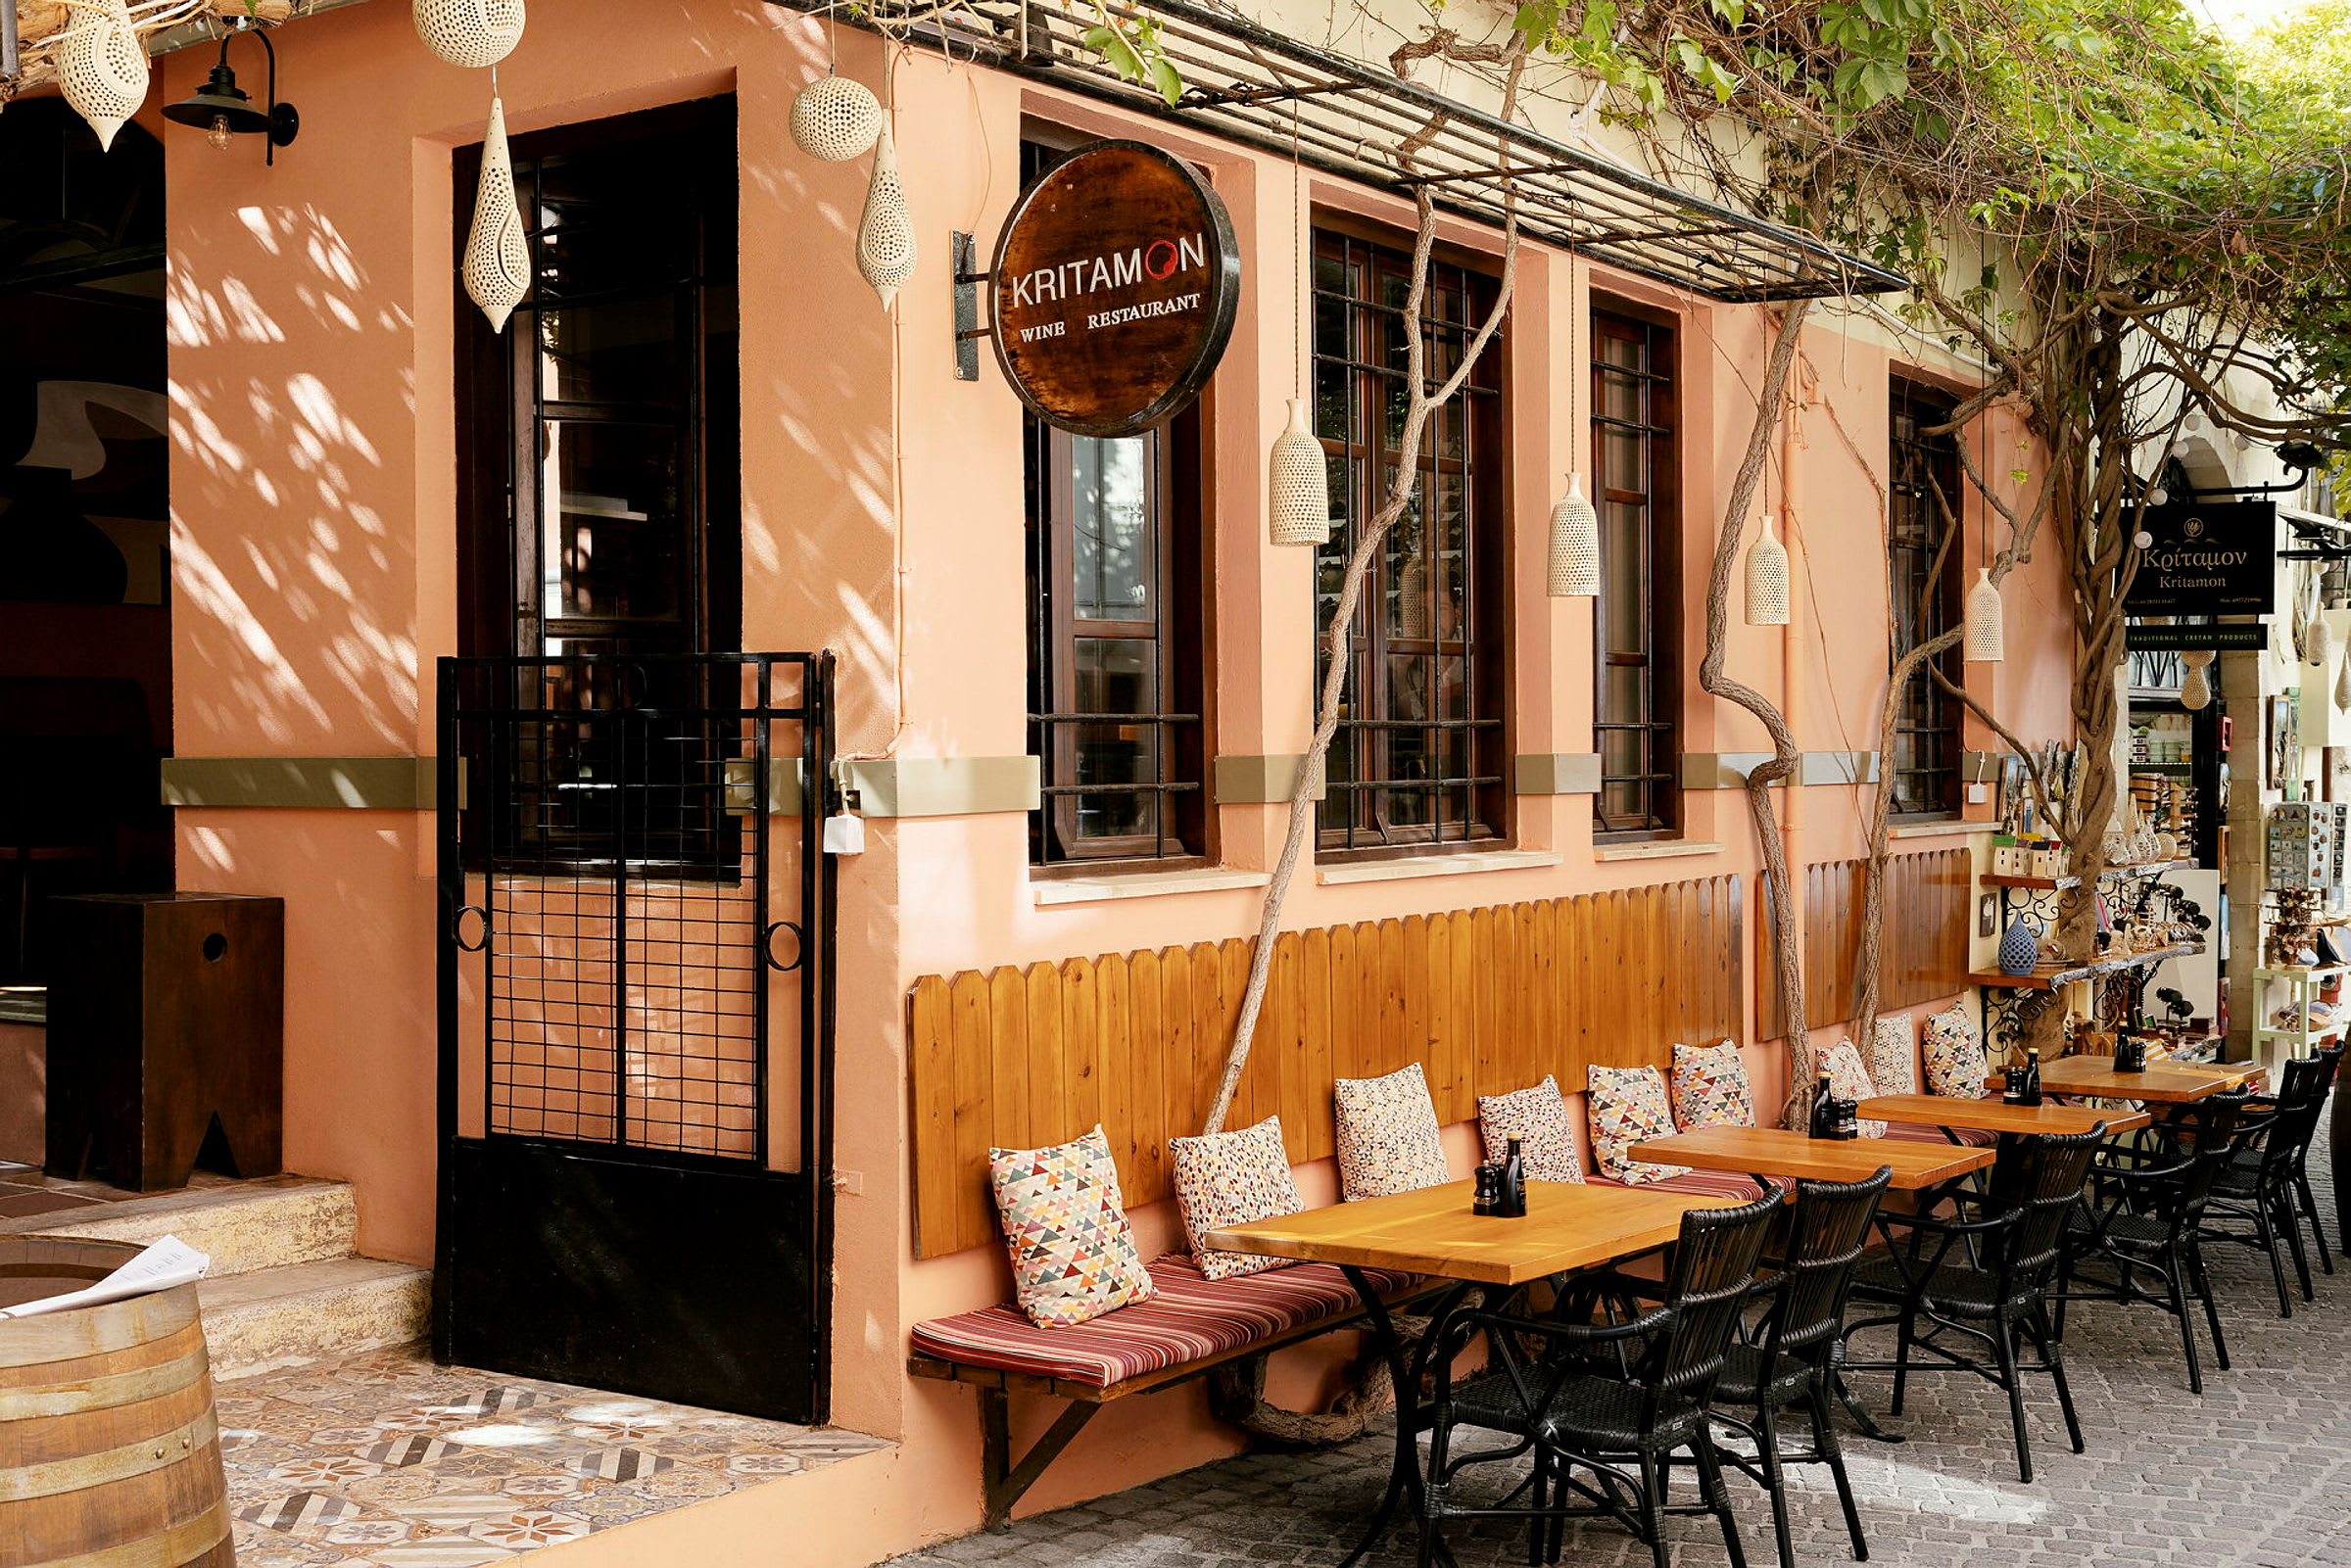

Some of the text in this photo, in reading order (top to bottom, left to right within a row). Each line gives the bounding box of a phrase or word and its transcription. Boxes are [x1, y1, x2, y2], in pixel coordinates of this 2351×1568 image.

[1013, 232, 1205, 309] KRITAMON
[1020, 293, 1201, 344] WINE RESTAURANT
[2142, 547, 2248, 572] Κρίταμον
[2159, 576, 2227, 589] Kritamon
